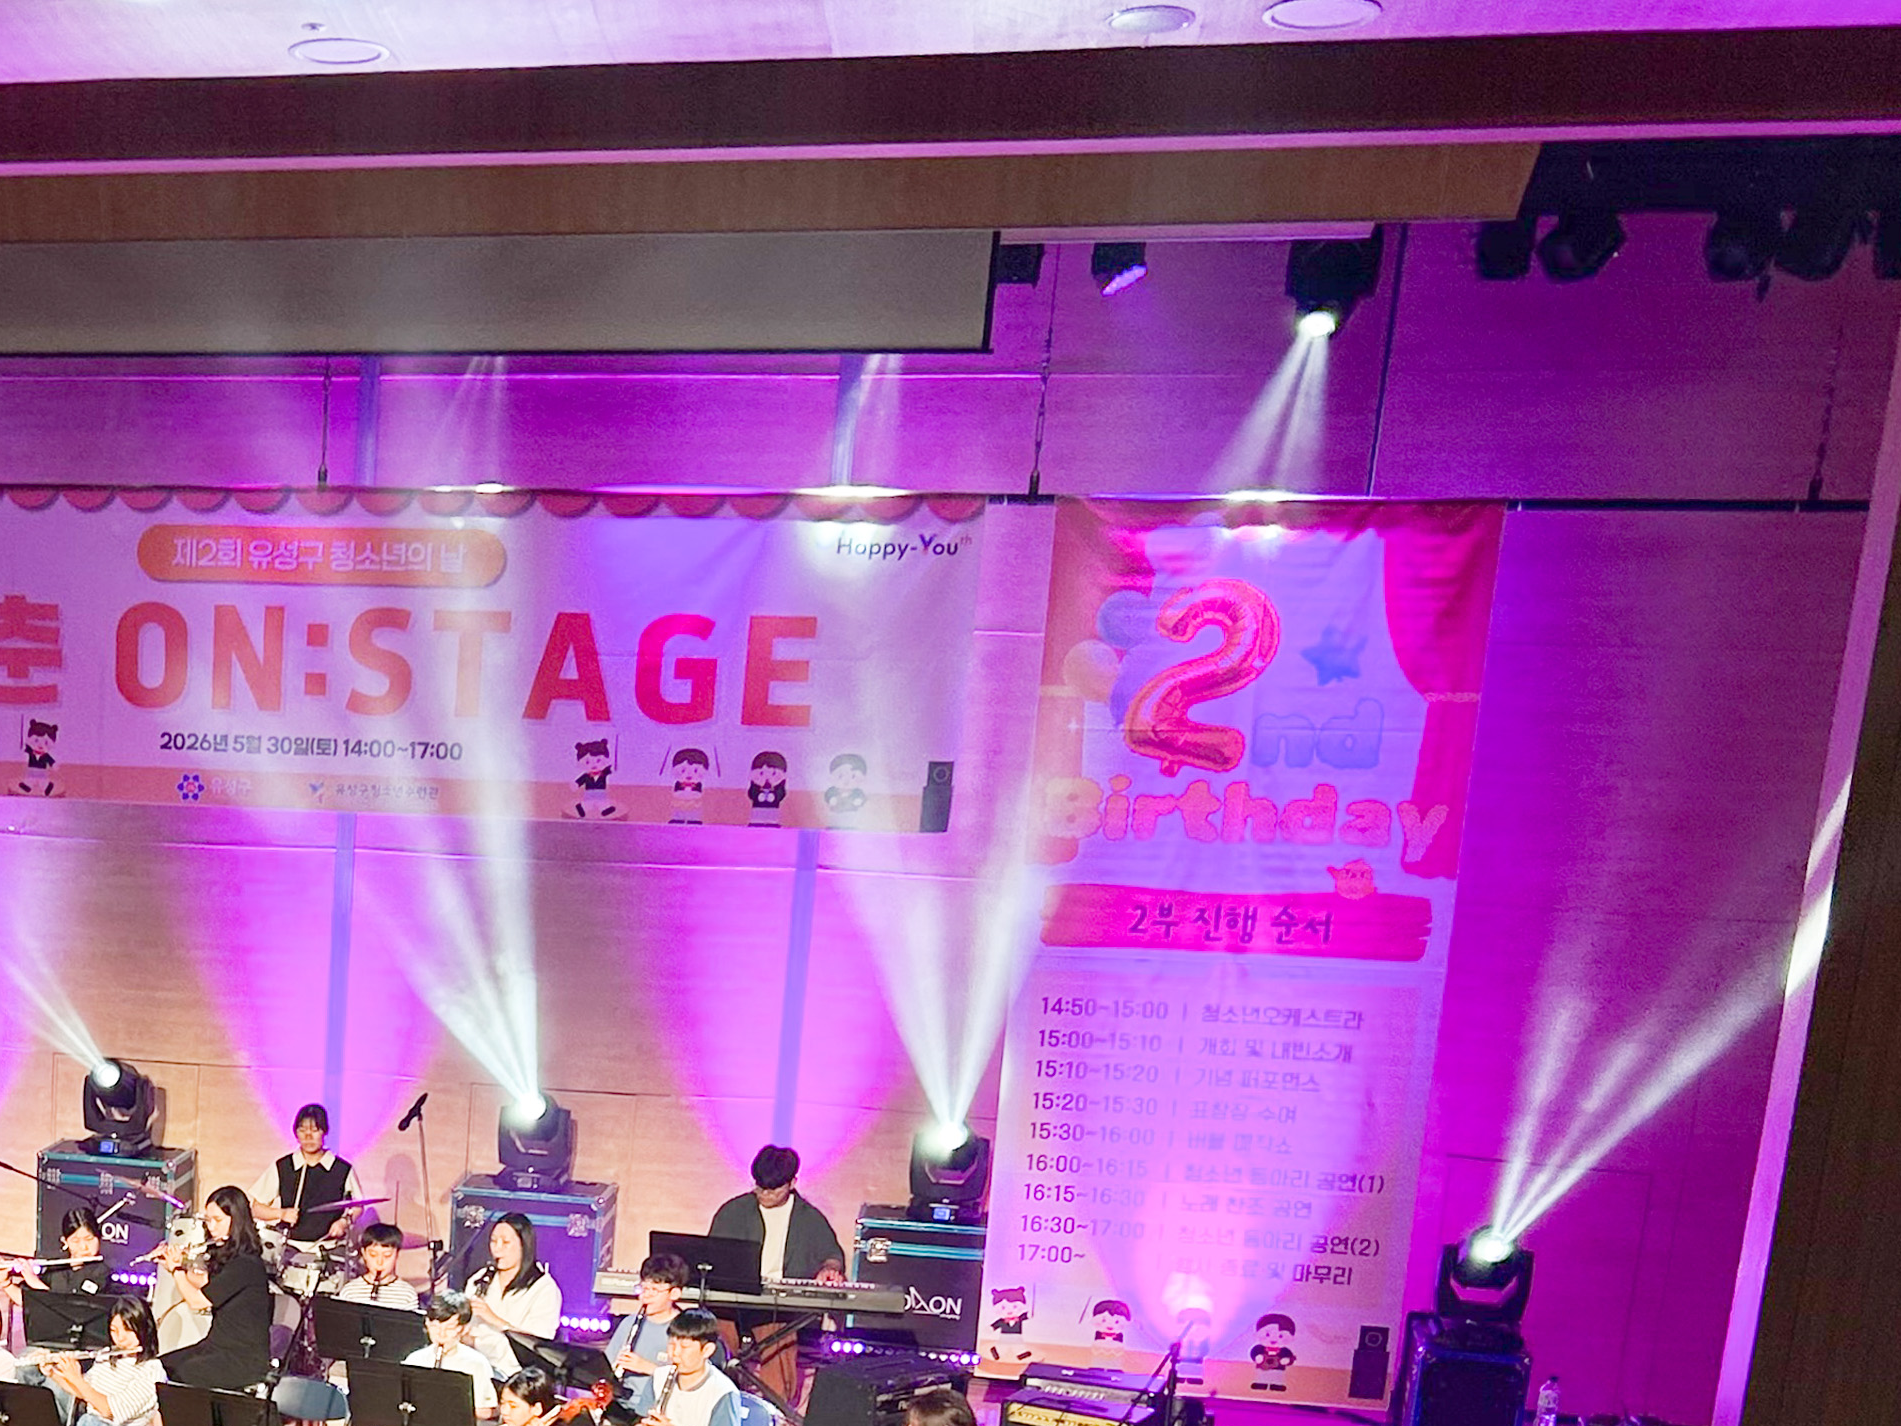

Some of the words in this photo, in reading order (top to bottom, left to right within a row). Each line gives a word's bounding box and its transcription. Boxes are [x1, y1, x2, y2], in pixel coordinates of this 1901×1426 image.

[172, 537, 242, 568] 제2회
[248, 539, 324, 571] 유성구
[330, 540, 432, 573] 청소년의
[114, 600, 819, 730] ON:STAGE
[159, 731, 228, 753] 2026년
[232, 735, 262, 754] 5월
[266, 736, 338, 757] 30일(토)
[342, 738, 463, 761] 14:00~17:00
[1042, 774, 1450, 864] Birthday
[1127, 904, 1180, 940] 2부
[1191, 902, 1258, 945] 진행
[1269, 906, 1334, 945] 순서
[1040, 995, 1169, 1020] 14:50~15:00
[1201, 1003, 1364, 1031] 청소년오케스트라
[1037, 1028, 1163, 1053] 15:00~15:10
[1199, 1037, 1237, 1058] 개회
[1244, 1039, 1264, 1059] 및
[1270, 1040, 1353, 1064] 내빈소개
[1034, 1059, 1159, 1084] 15:10~15:20
[1194, 1066, 1233, 1088] 기념
[1240, 1069, 1321, 1094] 퍼포먼스
[1032, 1091, 1158, 1115] 15:20~15:30
[1256, 1104, 1298, 1124] 수여
[1029, 1121, 1156, 1146] 15:30~16:00
[1025, 1152, 1148, 1177] 16:00~16:15
[1183, 1163, 1243, 1184] 청소년
[1315, 1171, 1386, 1195] 공연(1)
[1022, 1183, 1146, 1208] 16:15~16:30
[1272, 1198, 1313, 1219] 공연
[1019, 1214, 1146, 1240] 16:30~17:00
[1177, 1224, 1236, 1247] 청소년
[1309, 1234, 1381, 1258] 공연(2)
[1016, 1243, 1086, 1265] 17:00~
[1291, 1263, 1354, 1287] 마무리
